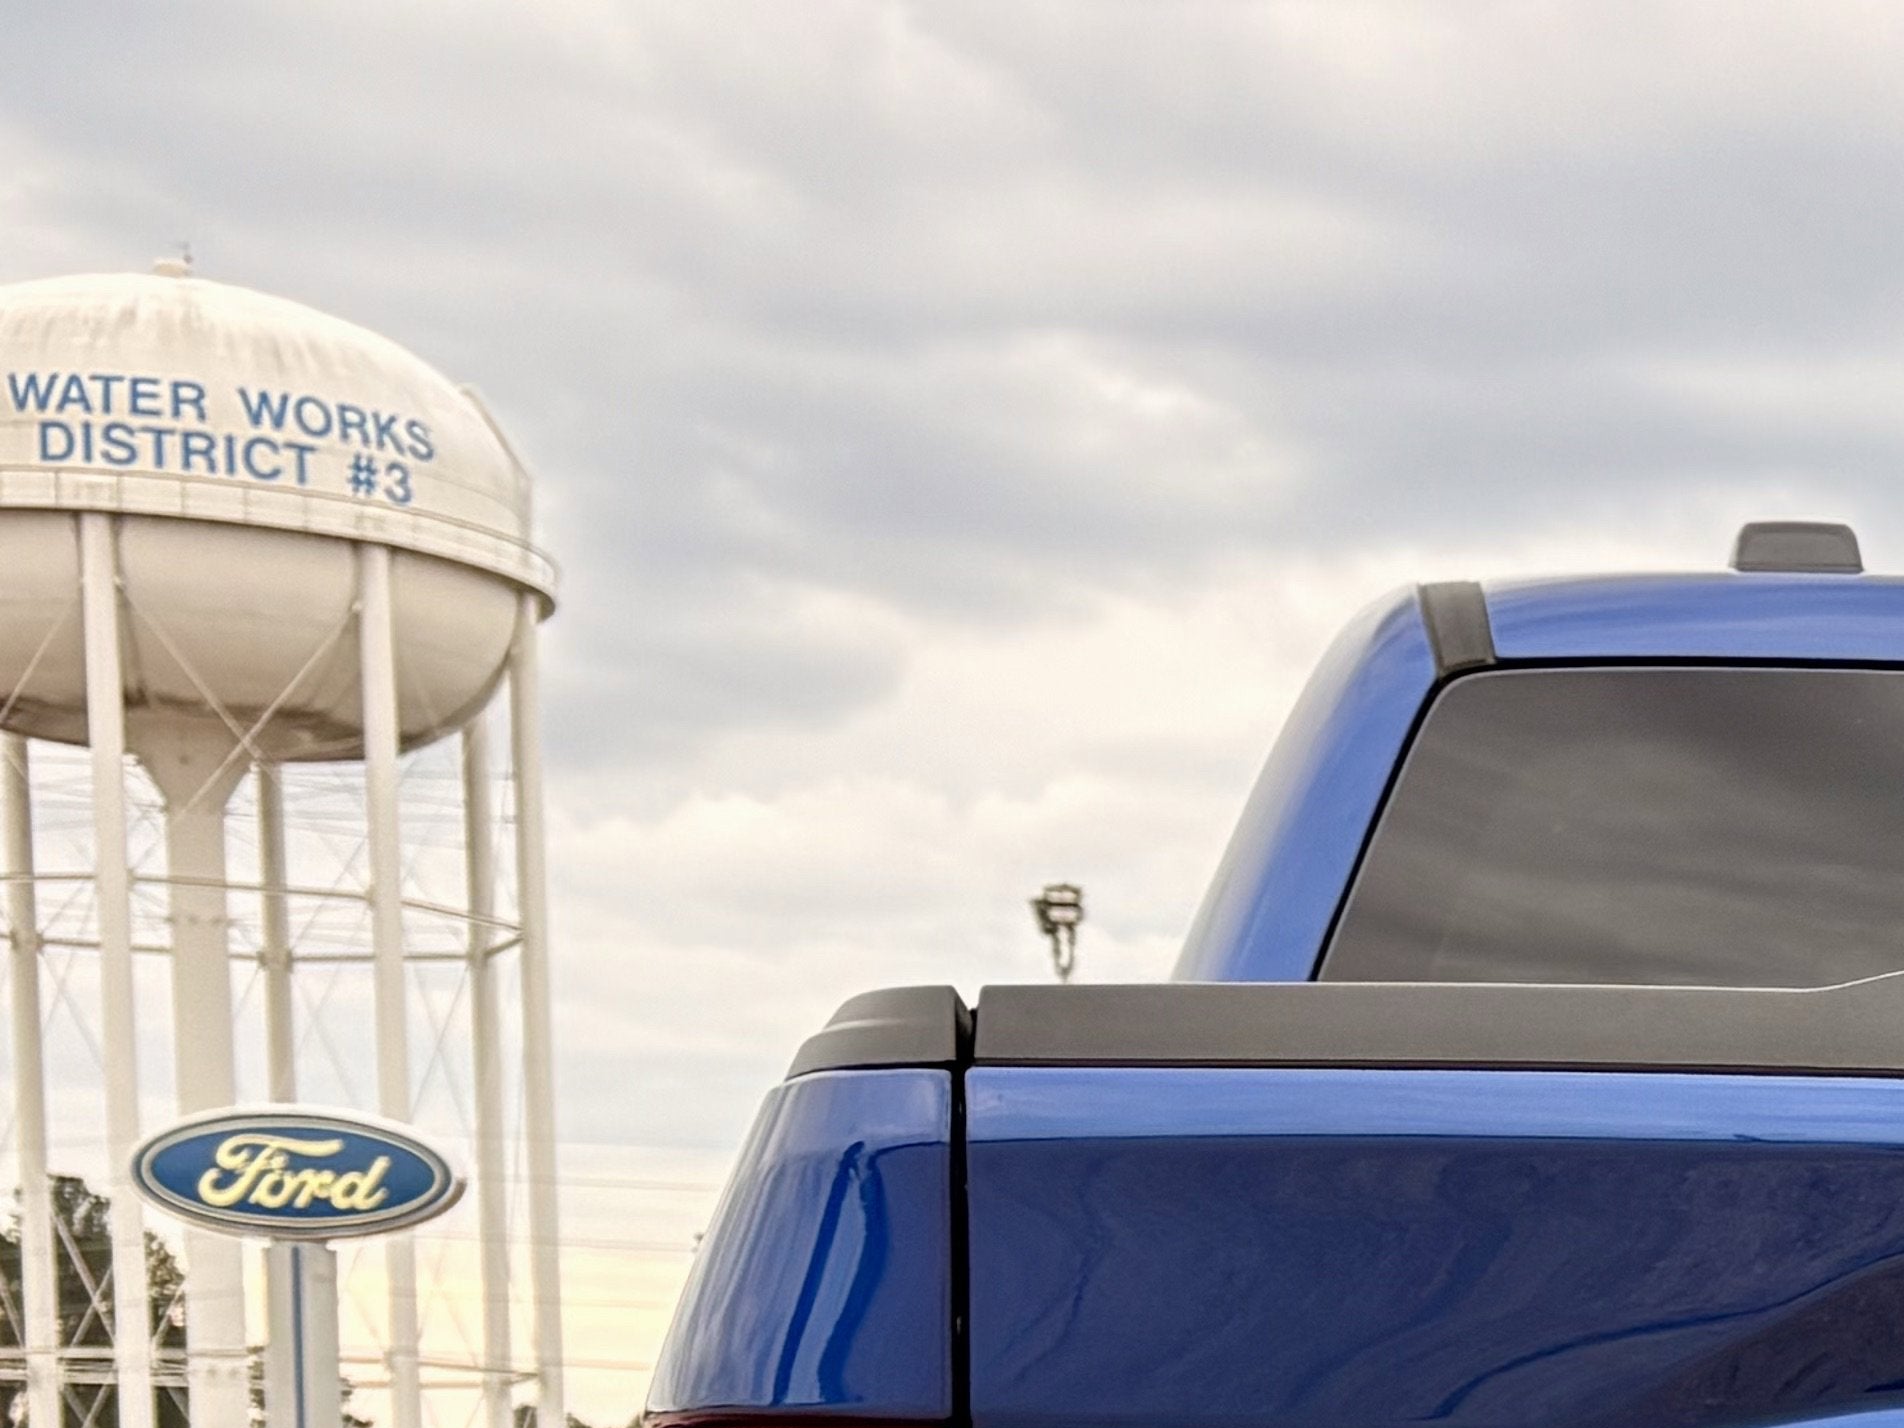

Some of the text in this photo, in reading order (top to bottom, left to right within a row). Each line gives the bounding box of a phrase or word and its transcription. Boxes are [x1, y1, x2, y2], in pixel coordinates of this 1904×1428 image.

[8, 372, 435, 461] WATER WORKS
[39, 421, 412, 506] DISTRICT #3
[198, 1133, 391, 1210] Ford
